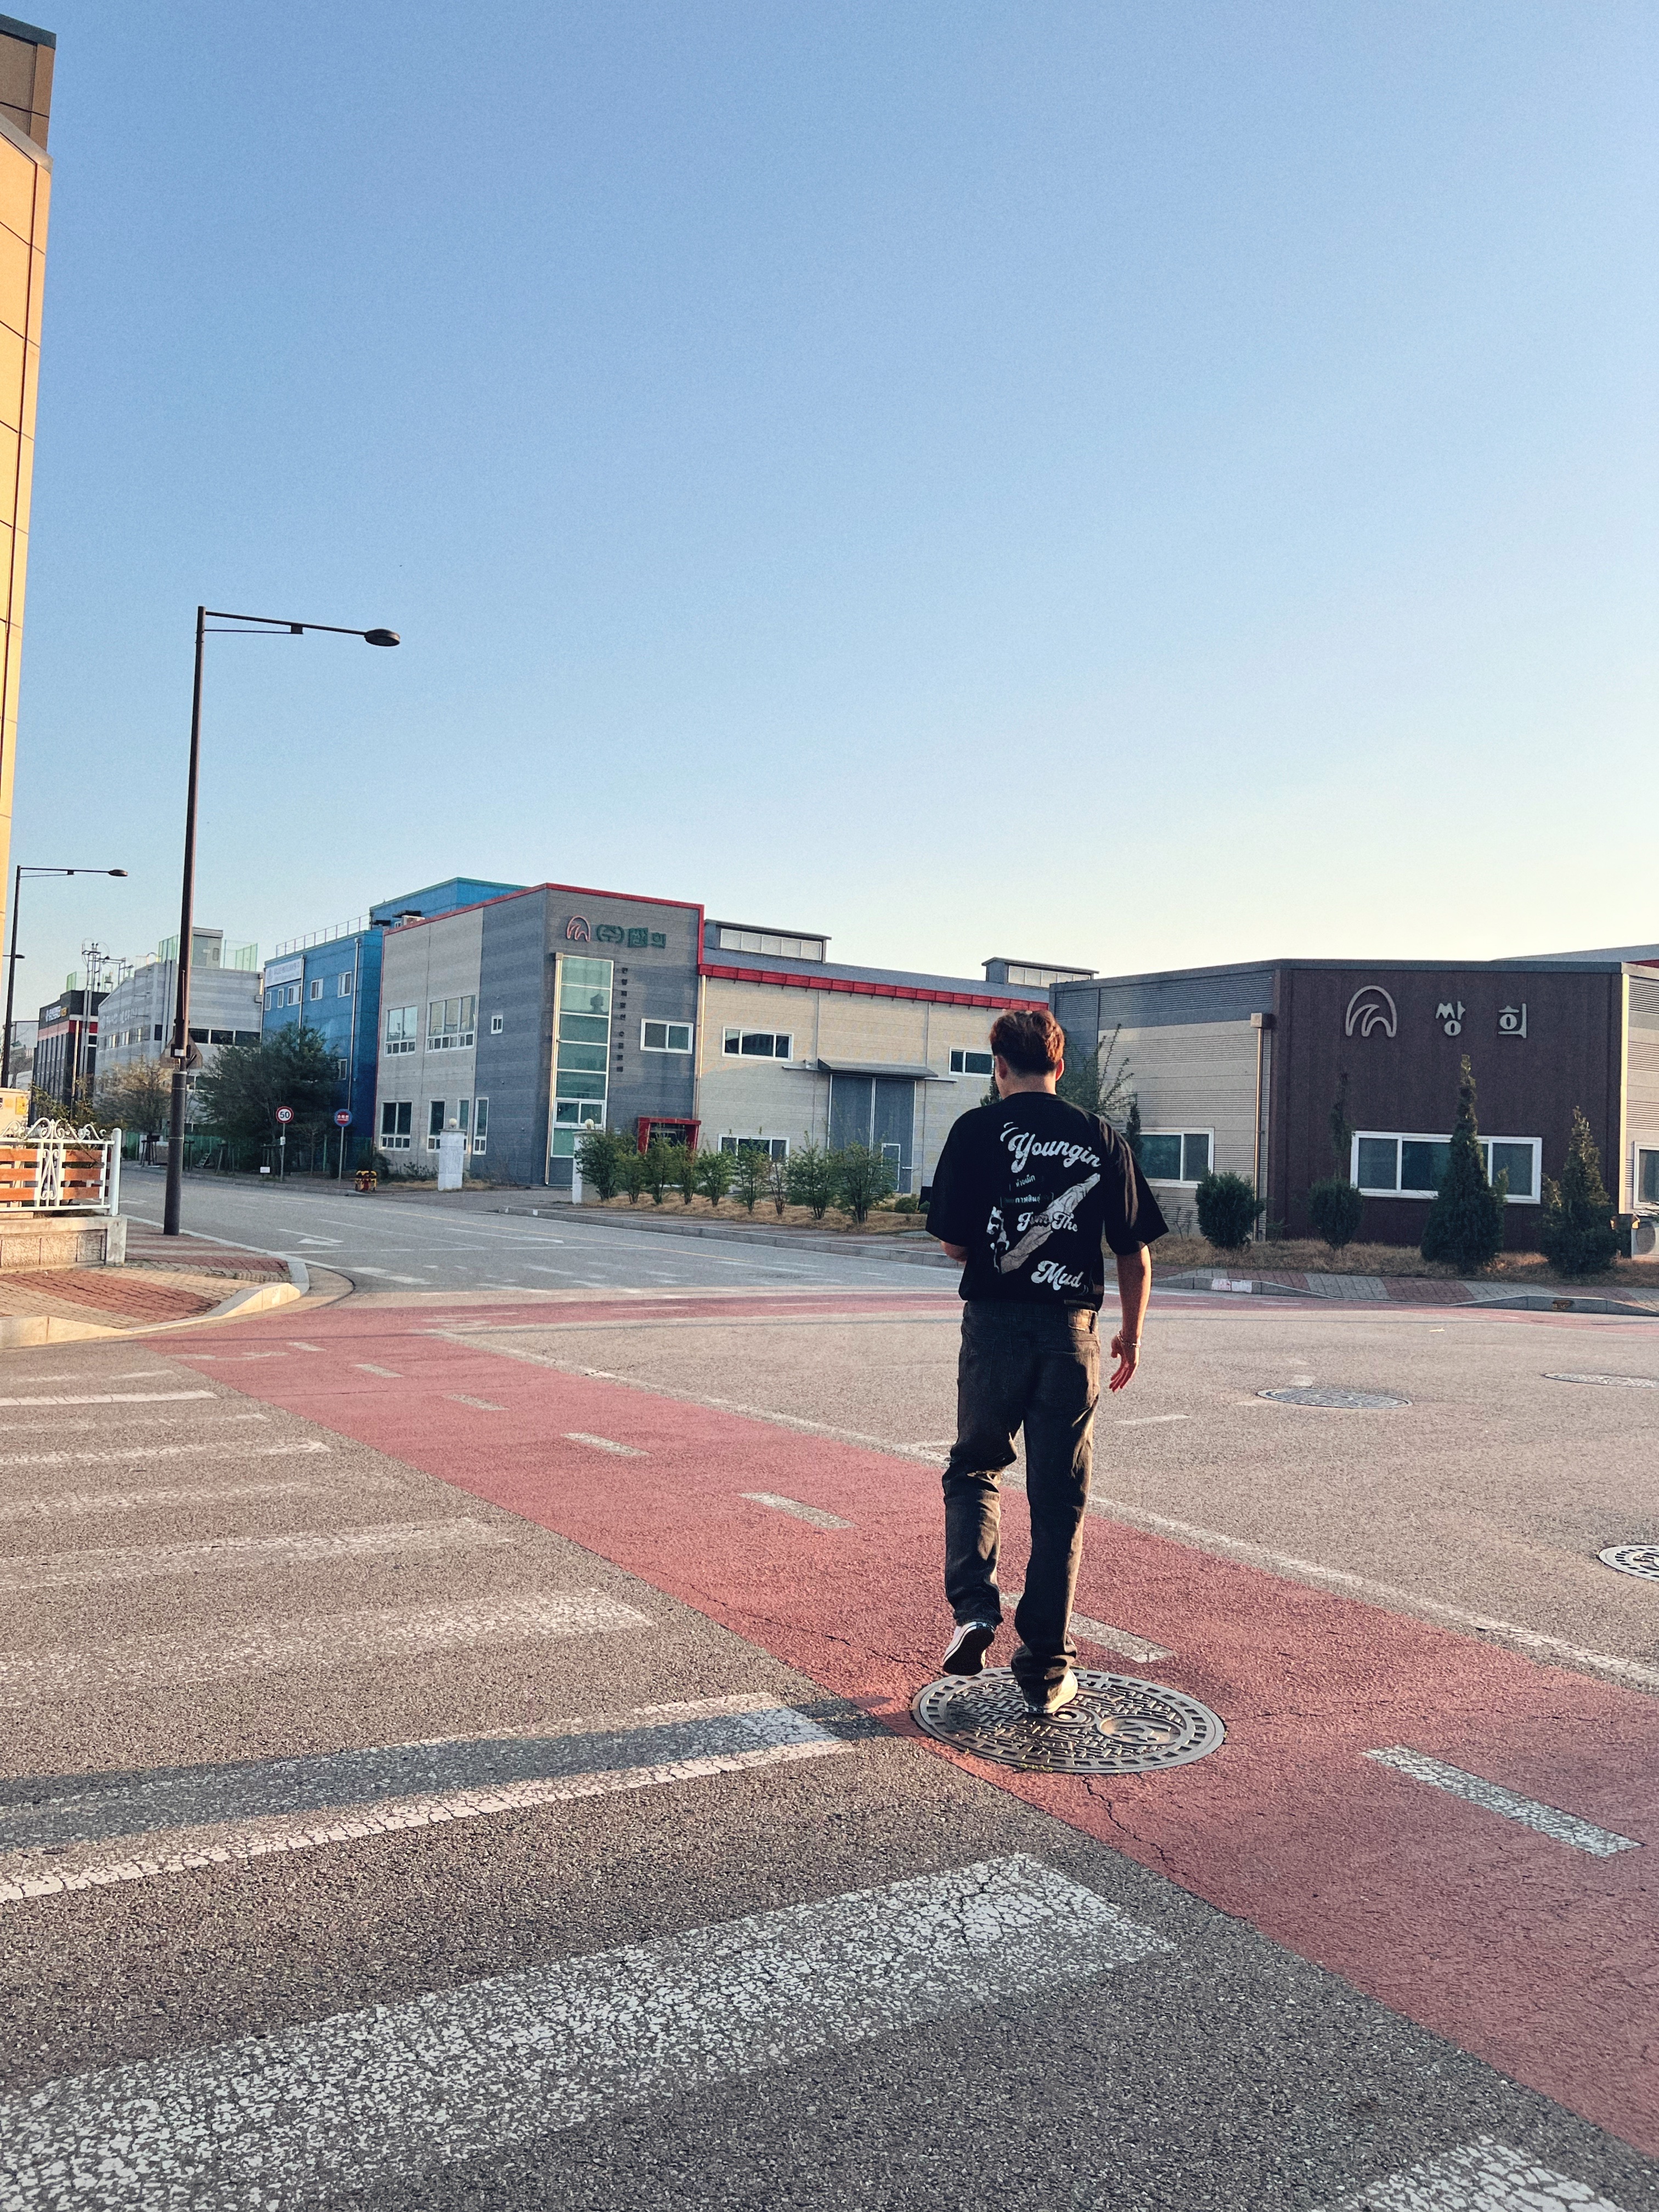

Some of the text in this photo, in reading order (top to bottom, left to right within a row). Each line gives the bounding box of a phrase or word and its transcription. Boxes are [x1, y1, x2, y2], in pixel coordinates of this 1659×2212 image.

[1435, 1001, 1527, 1039] 쌍희
[1051, 1211, 1078, 1232] The
[1031, 1261, 1084, 1291] Mud
